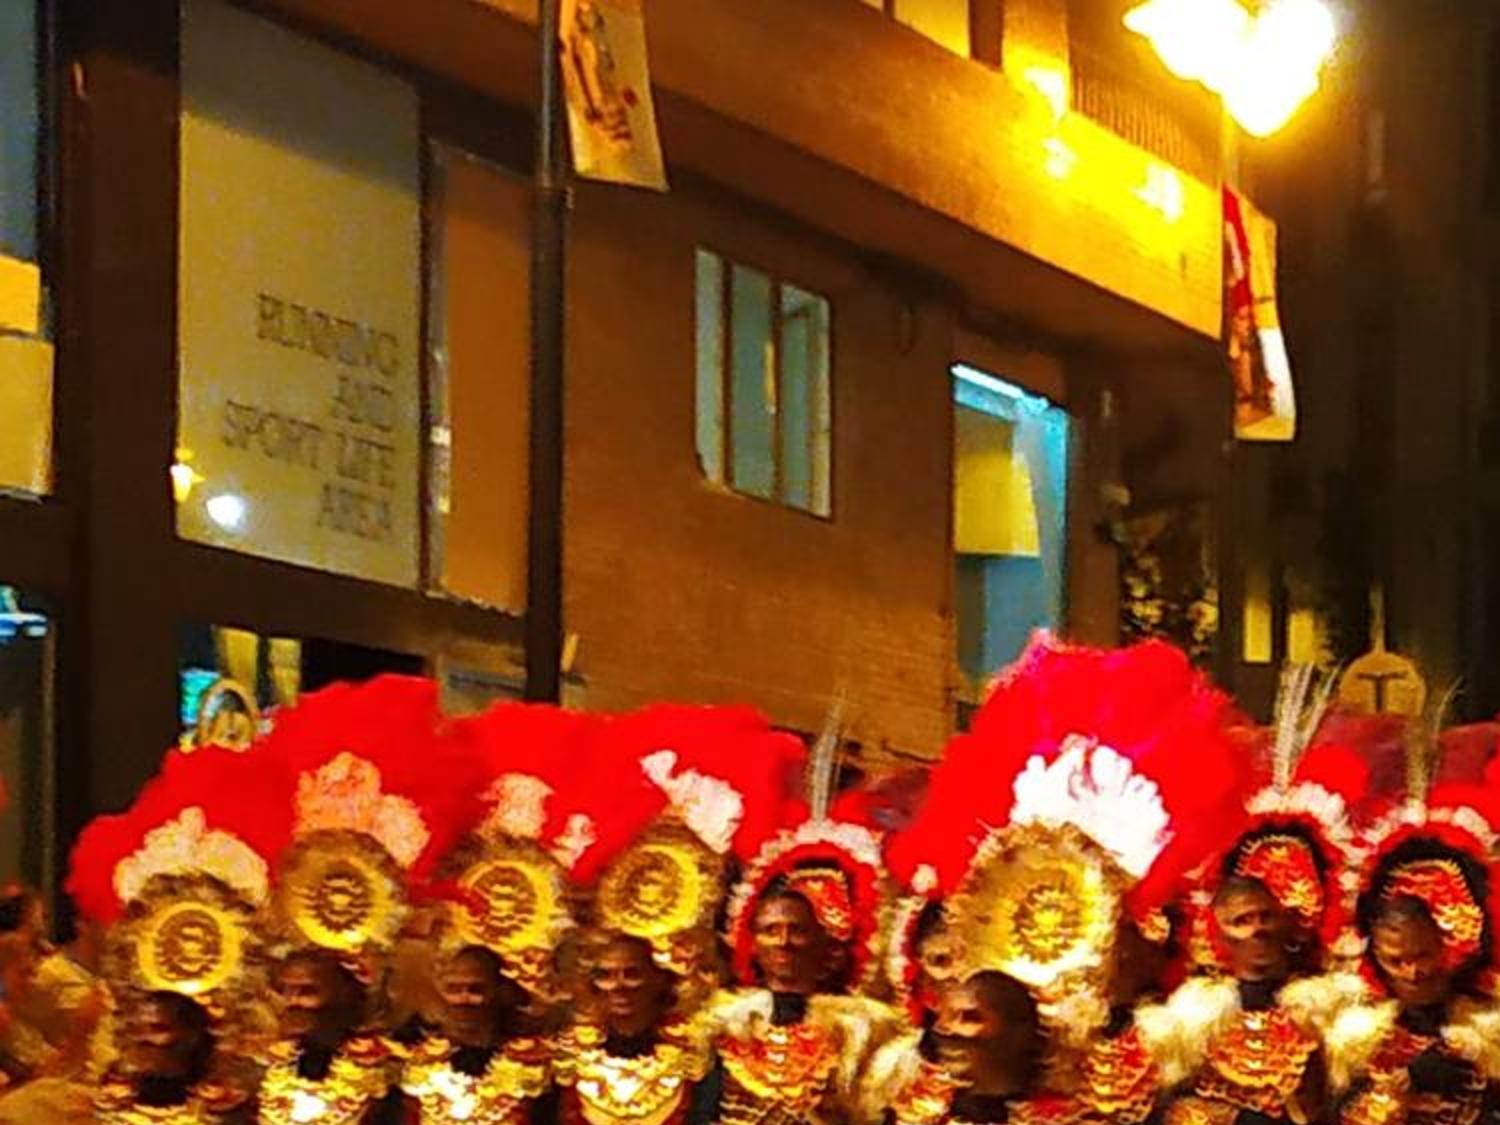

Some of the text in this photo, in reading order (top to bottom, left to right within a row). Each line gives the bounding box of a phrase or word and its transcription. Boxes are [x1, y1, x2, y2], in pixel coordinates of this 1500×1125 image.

[257, 293, 399, 378] RUNNING
[221, 399, 396, 489] SPORT LIFE
[316, 482, 392, 542] AREA
